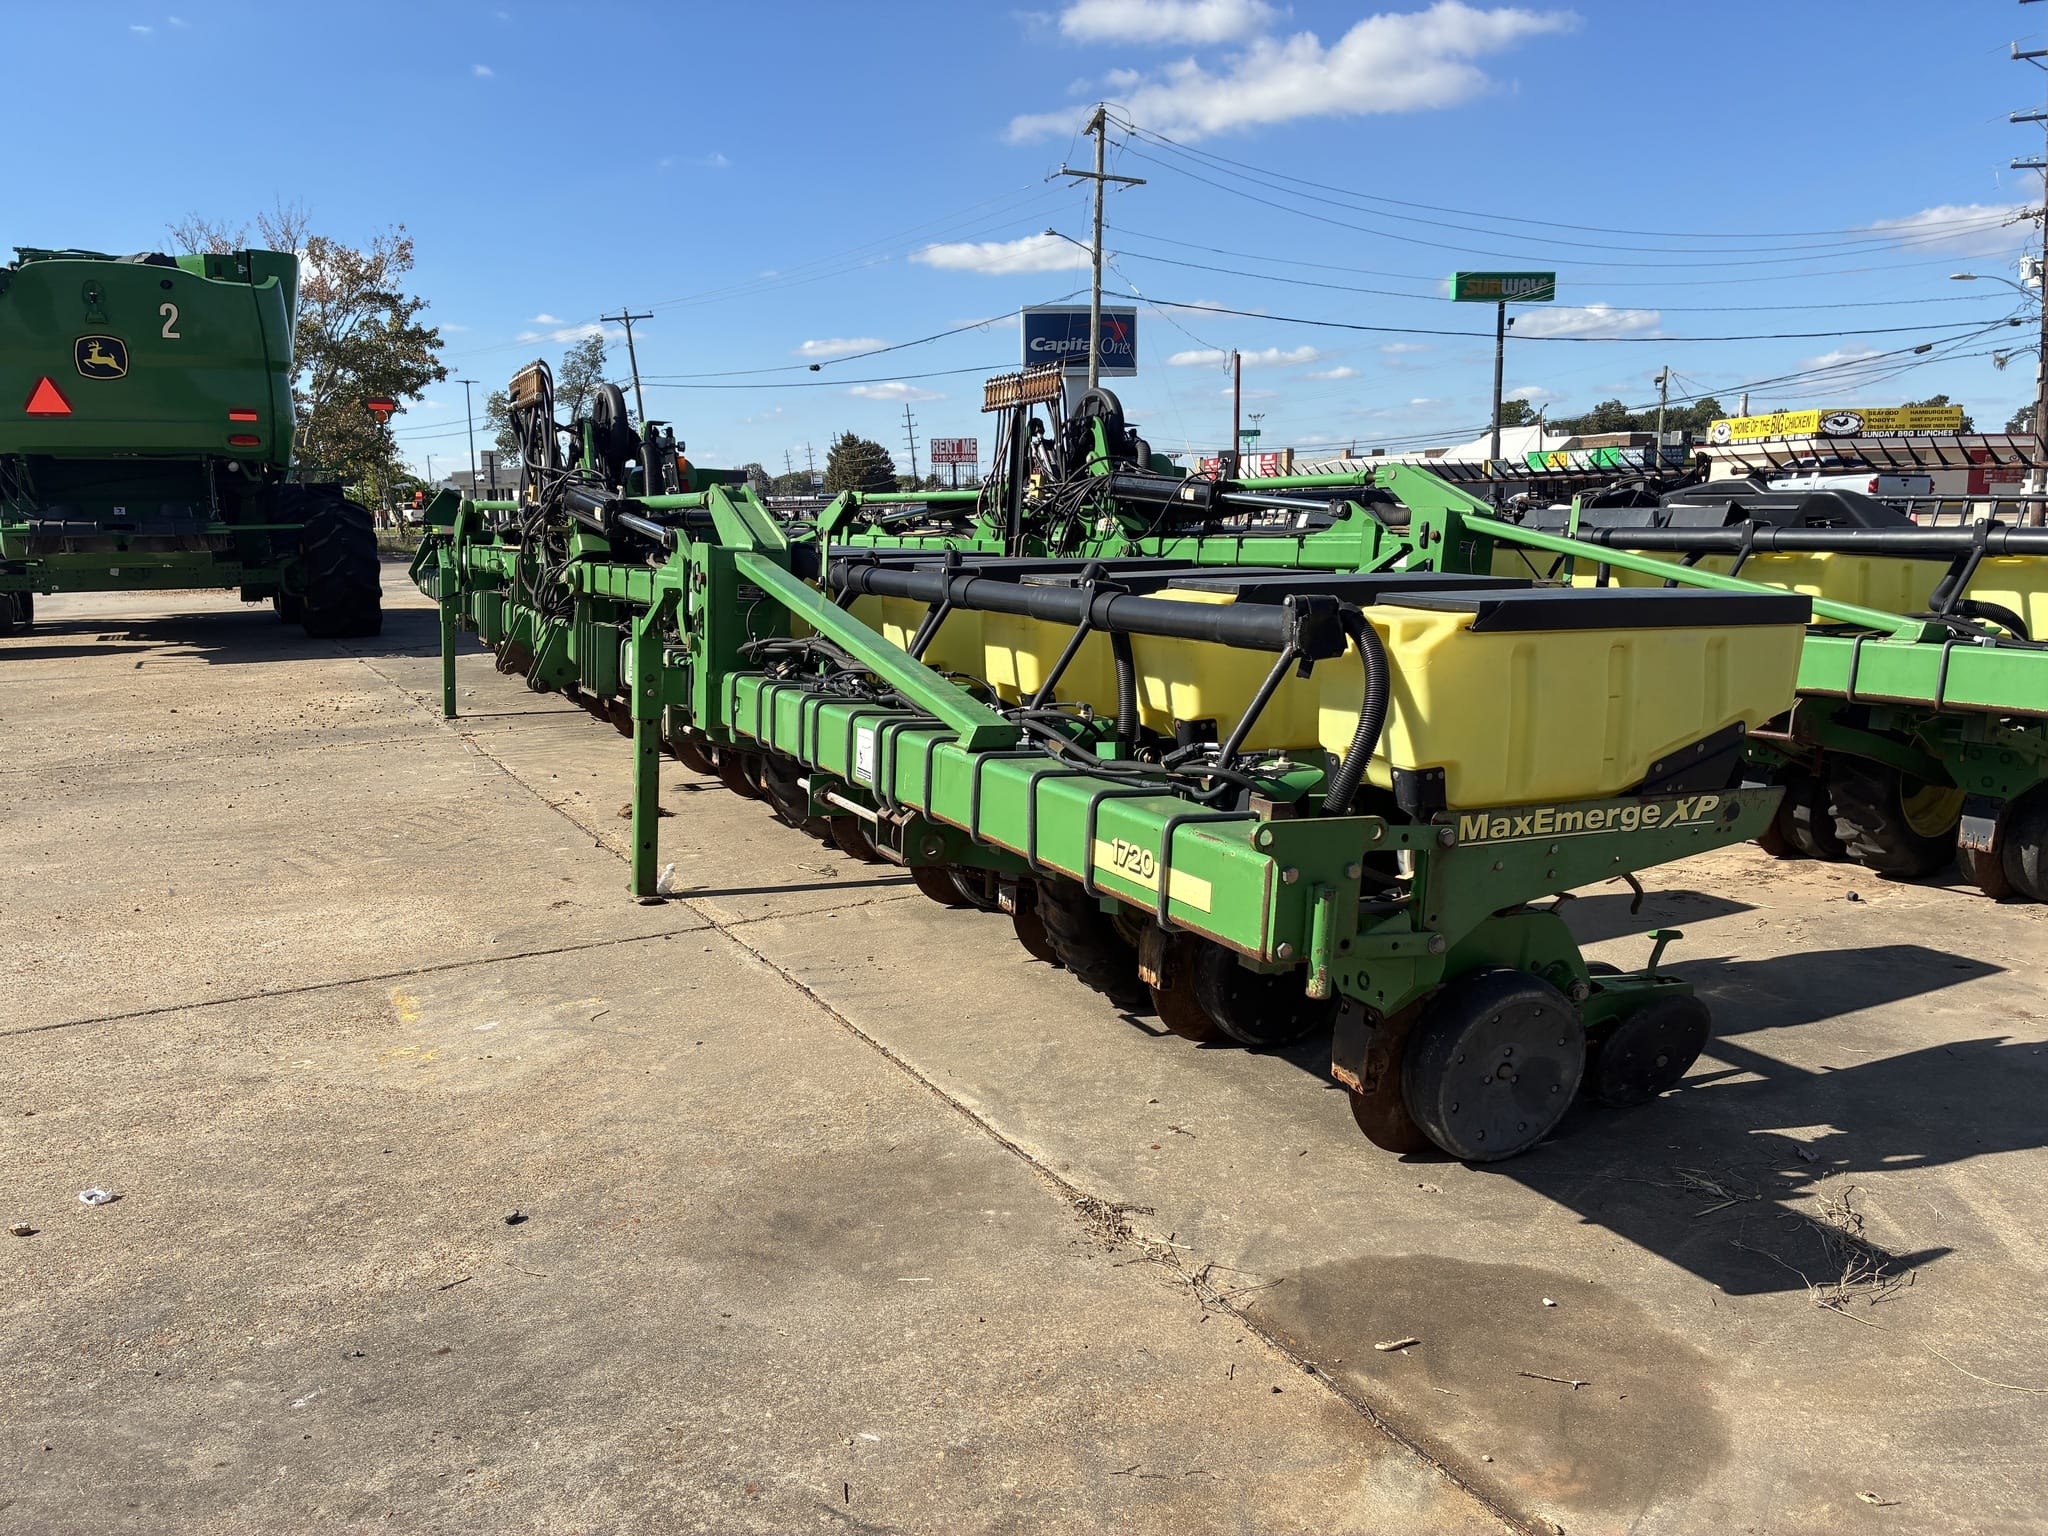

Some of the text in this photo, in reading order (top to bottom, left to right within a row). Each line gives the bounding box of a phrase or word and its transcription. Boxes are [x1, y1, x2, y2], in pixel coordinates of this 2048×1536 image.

[159, 302, 181, 339] 2
[1030, 336, 1132, 355] Capita One
[1734, 421, 1749, 434] HOME
[1750, 420, 1759, 432] OF
[1760, 419, 1770, 432] THE
[1770, 414, 1784, 434] BIG
[1862, 430, 1896, 438] SUNDAY
[1917, 429, 1954, 437] LUNCHES
[932, 439, 977, 455] RENT ME
[1458, 795, 1720, 842] MaxEmerge XP
[1110, 837, 1155, 879] 1720
